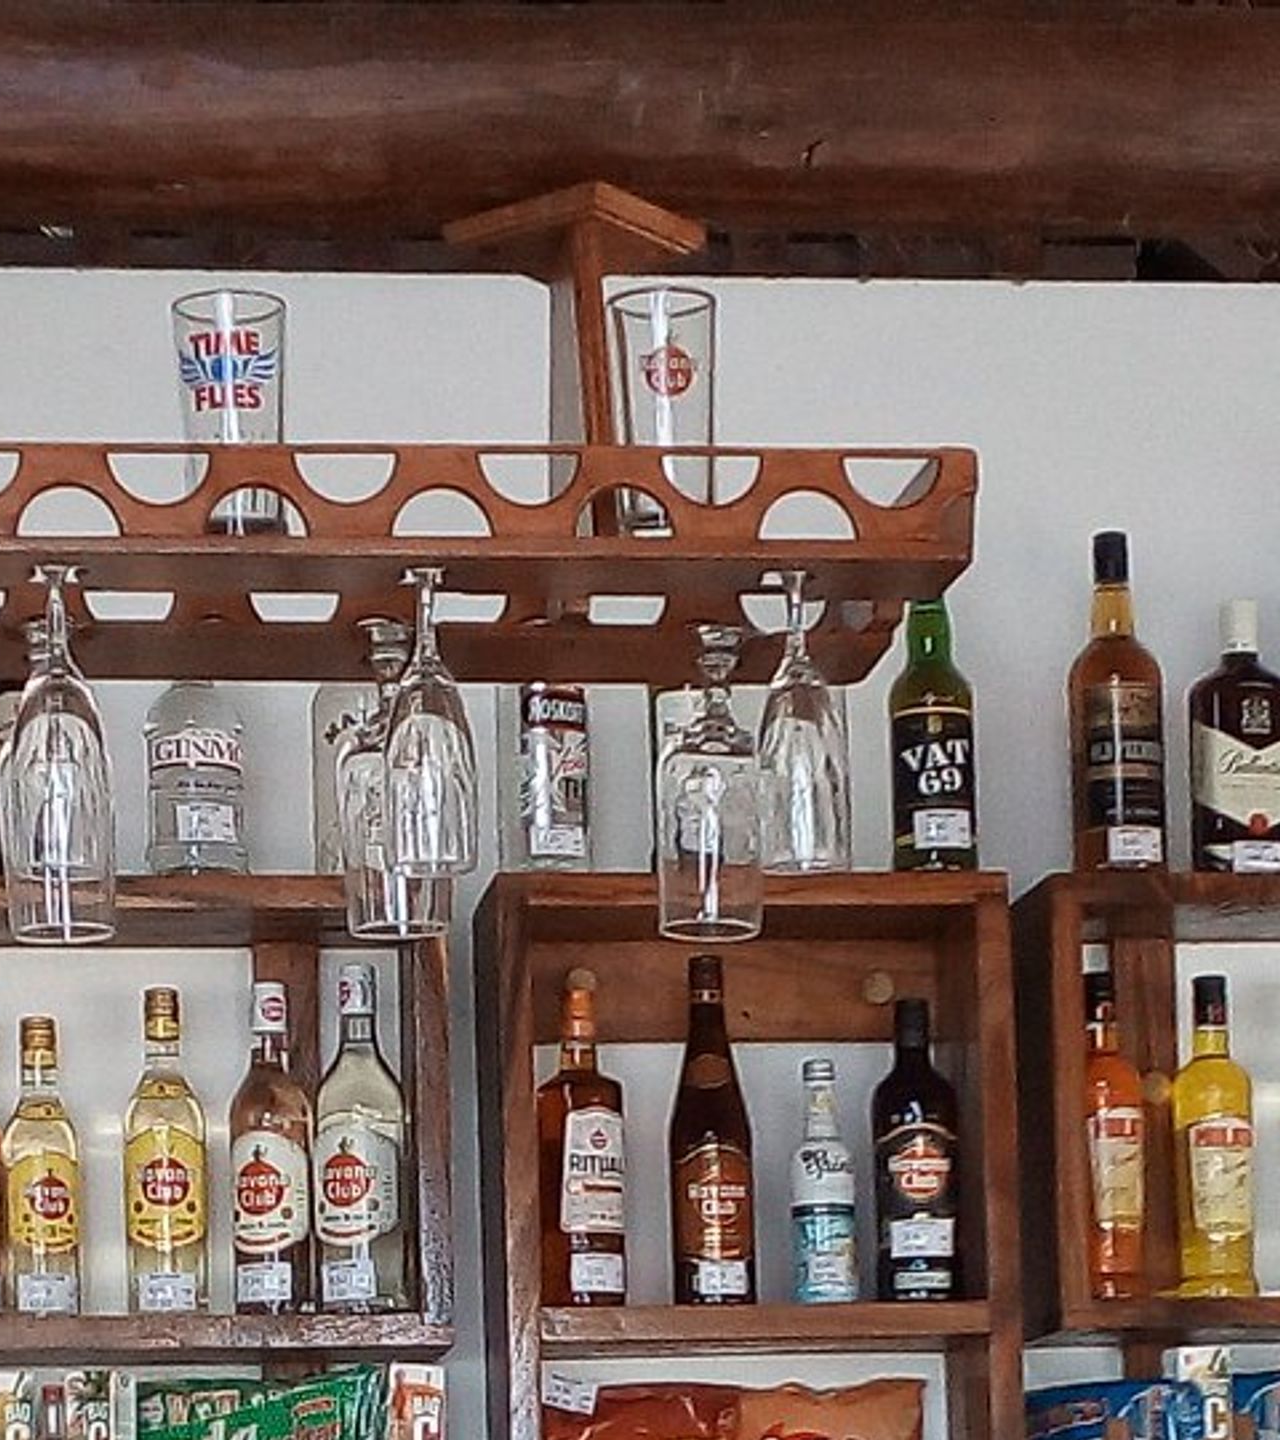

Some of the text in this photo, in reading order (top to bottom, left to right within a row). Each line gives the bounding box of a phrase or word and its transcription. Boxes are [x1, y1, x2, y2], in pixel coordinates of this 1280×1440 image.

[193, 383, 262, 411] FLIES
[900, 738, 969, 771] VAT
[918, 766, 962, 795] 69
[326, 1182, 362, 1199] Club
